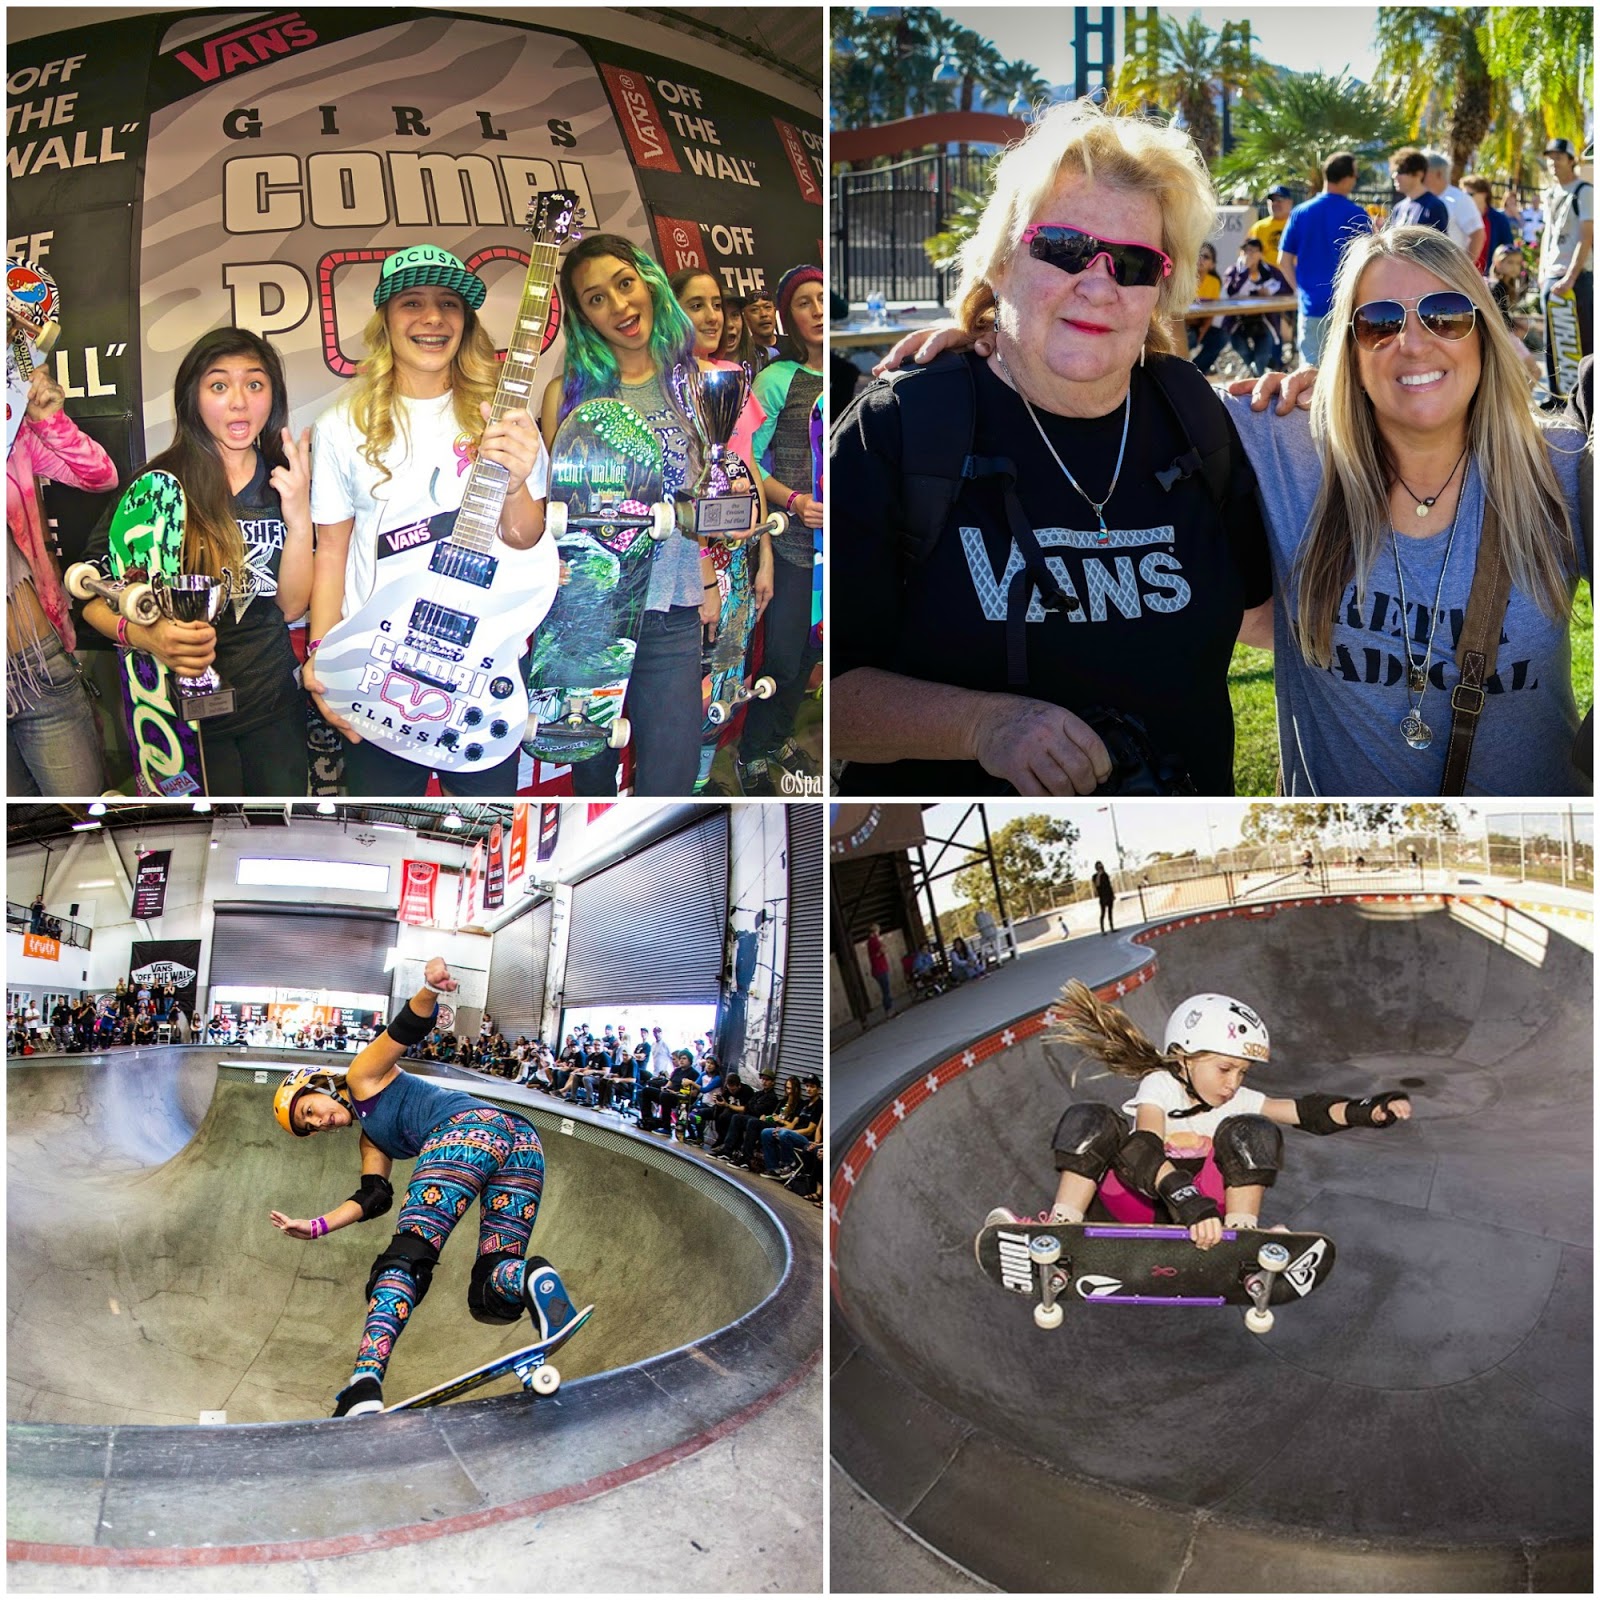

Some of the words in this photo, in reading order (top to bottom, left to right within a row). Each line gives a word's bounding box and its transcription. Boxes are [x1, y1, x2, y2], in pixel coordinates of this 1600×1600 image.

[175, 12, 319, 83] VANS
[7, 54, 86, 96] OFF
[645, 74, 704, 110] "OFF
[7, 92, 78, 137] THE
[222, 105, 577, 148] GIRLS
[668, 109, 721, 146] THE
[682, 145, 761, 189] WALL"
[222, 150, 600, 235] COMBI
[7, 229, 54, 266] FF
[699, 223, 755, 256] "OFF
[394, 250, 459, 270] DCUSA
[719, 266, 766, 297] THE
[19, 343, 35, 376] OHAN
[386, 519, 432, 552] VANS
[959, 525, 1192, 623] VANS
[351, 702, 460, 755] CLASSIC
[29, 937, 56, 955] truth
[151, 963, 173, 972] VANS
[153, 972, 169, 983] THE
[996, 1230, 1034, 1295] TONIC
